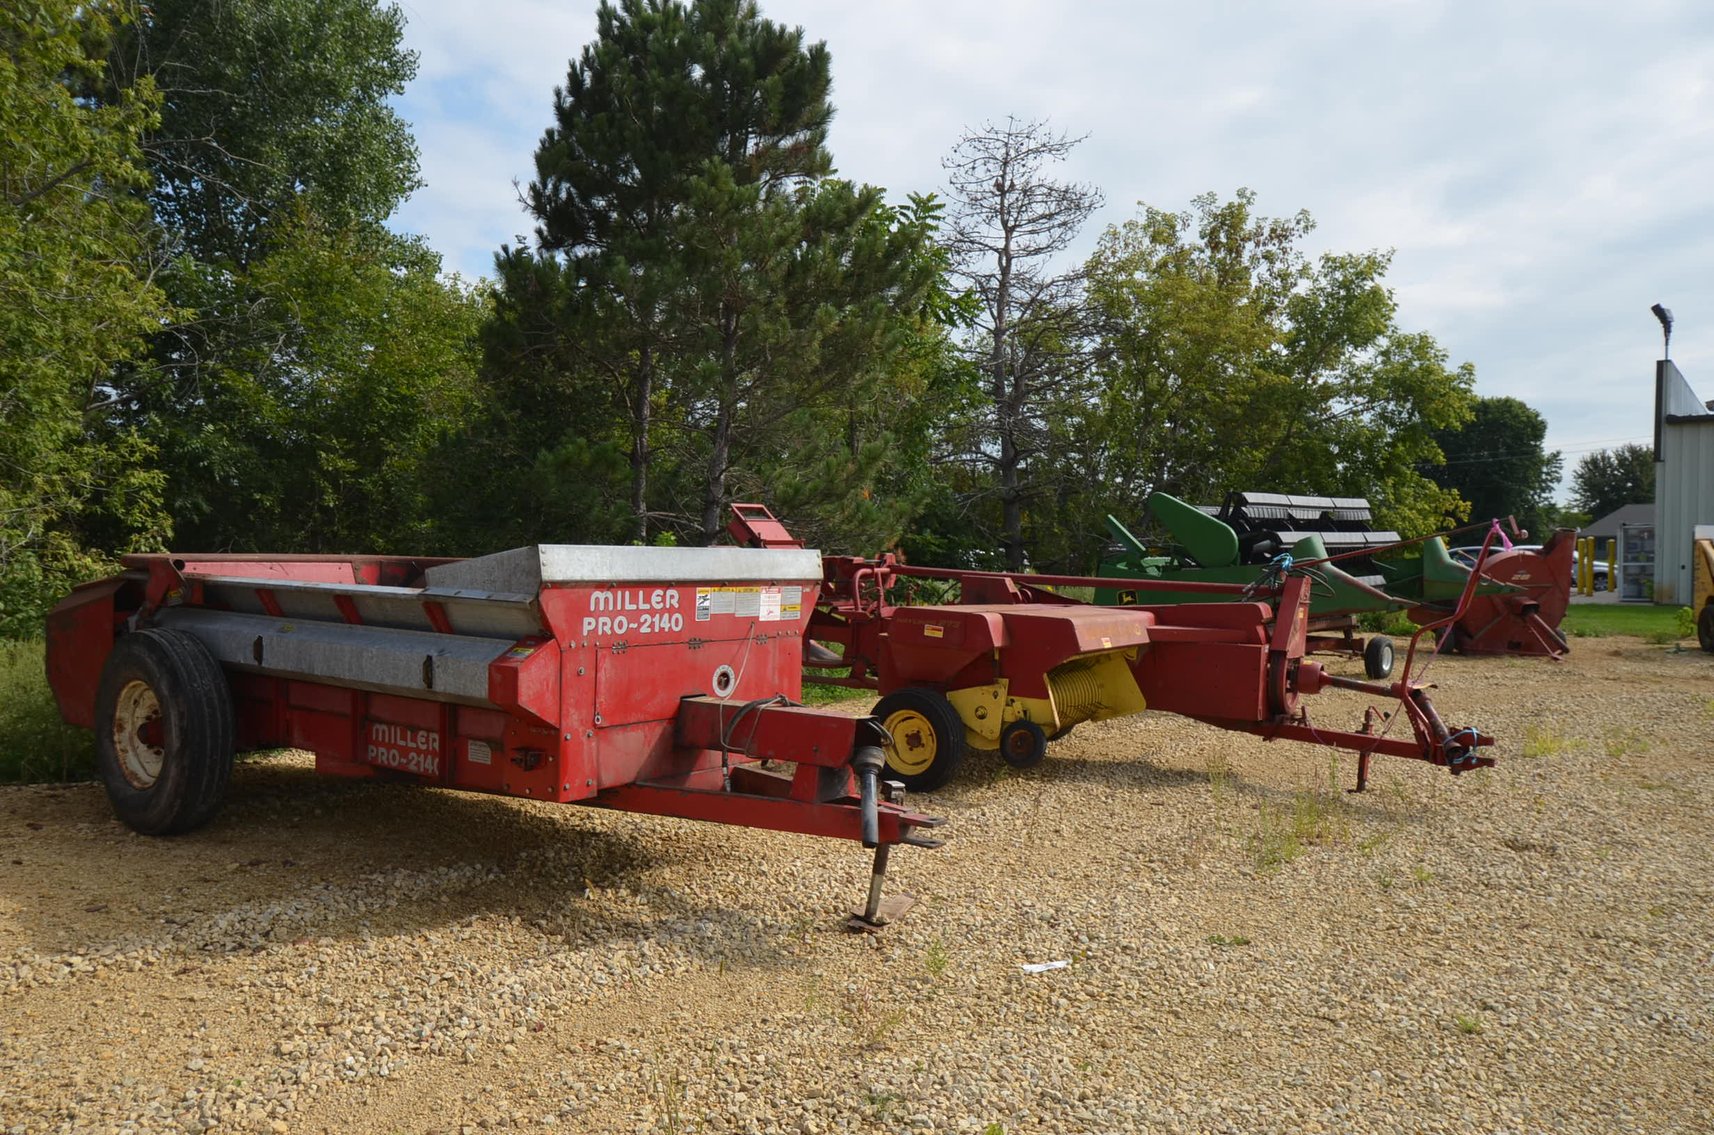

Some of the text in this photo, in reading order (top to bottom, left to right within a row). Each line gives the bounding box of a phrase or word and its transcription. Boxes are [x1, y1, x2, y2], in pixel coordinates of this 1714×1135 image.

[590, 589, 679, 611] MILLER
[582, 612, 684, 636] PRO-2140
[372, 723, 439, 752] MILLER
